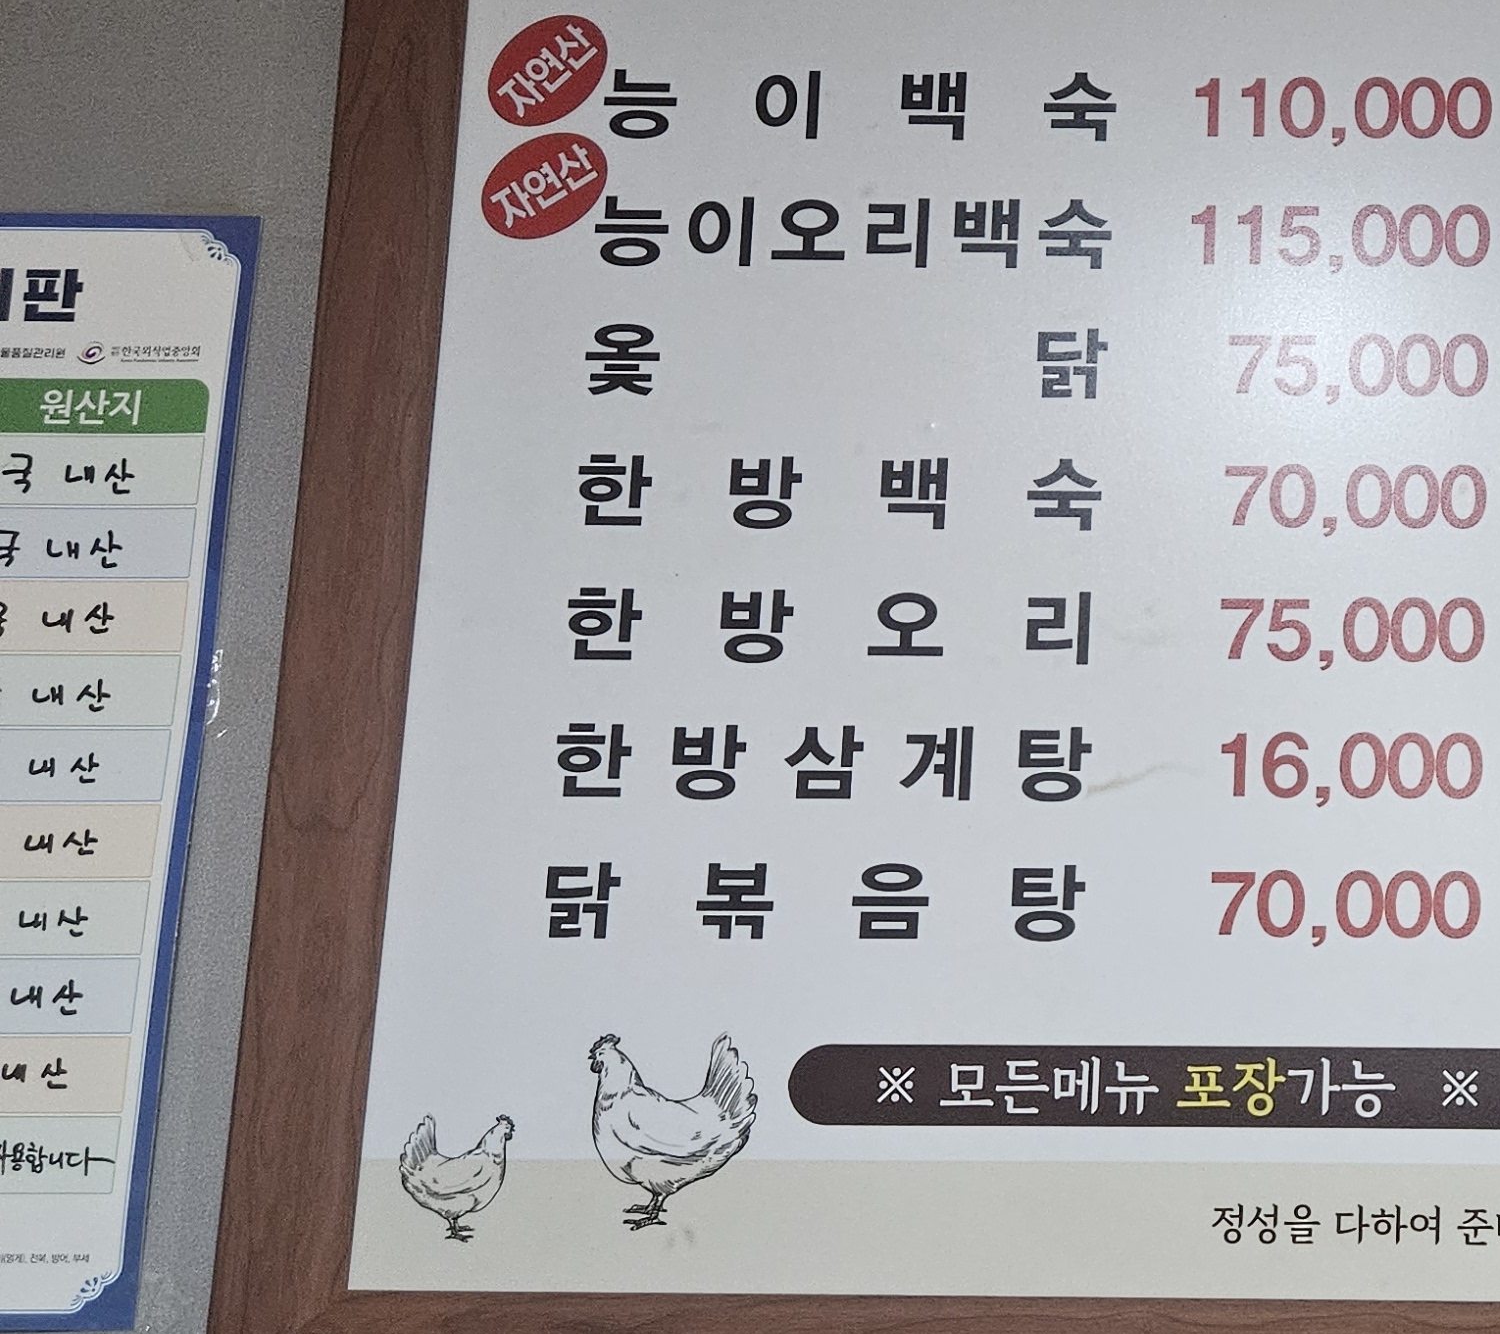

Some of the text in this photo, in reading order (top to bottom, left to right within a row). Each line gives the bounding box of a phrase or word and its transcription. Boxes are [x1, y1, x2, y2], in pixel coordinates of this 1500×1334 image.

[497, 23, 599, 118] 자연산
[1195, 77, 1492, 144] 110,000
[490, 143, 599, 229] 자연산
[595, 196, 1492, 272] 능이오리백숙 115,000
[1229, 332, 1490, 403] 75,000
[40, 390, 141, 425] 원산지
[1225, 465, 1487, 535] 70,000
[1221, 598, 1484, 670] 75,000
[557, 723, 1482, 806] 한방삼계탕 16,000
[1211, 870, 1480, 946] 70,000
[940, 1056, 1159, 1114] 모든메뉴
[1177, 1057, 1395, 1117] 포장가능
[1212, 1203, 1321, 1244] 정성을
[1335, 1204, 1440, 1245] 다하여
